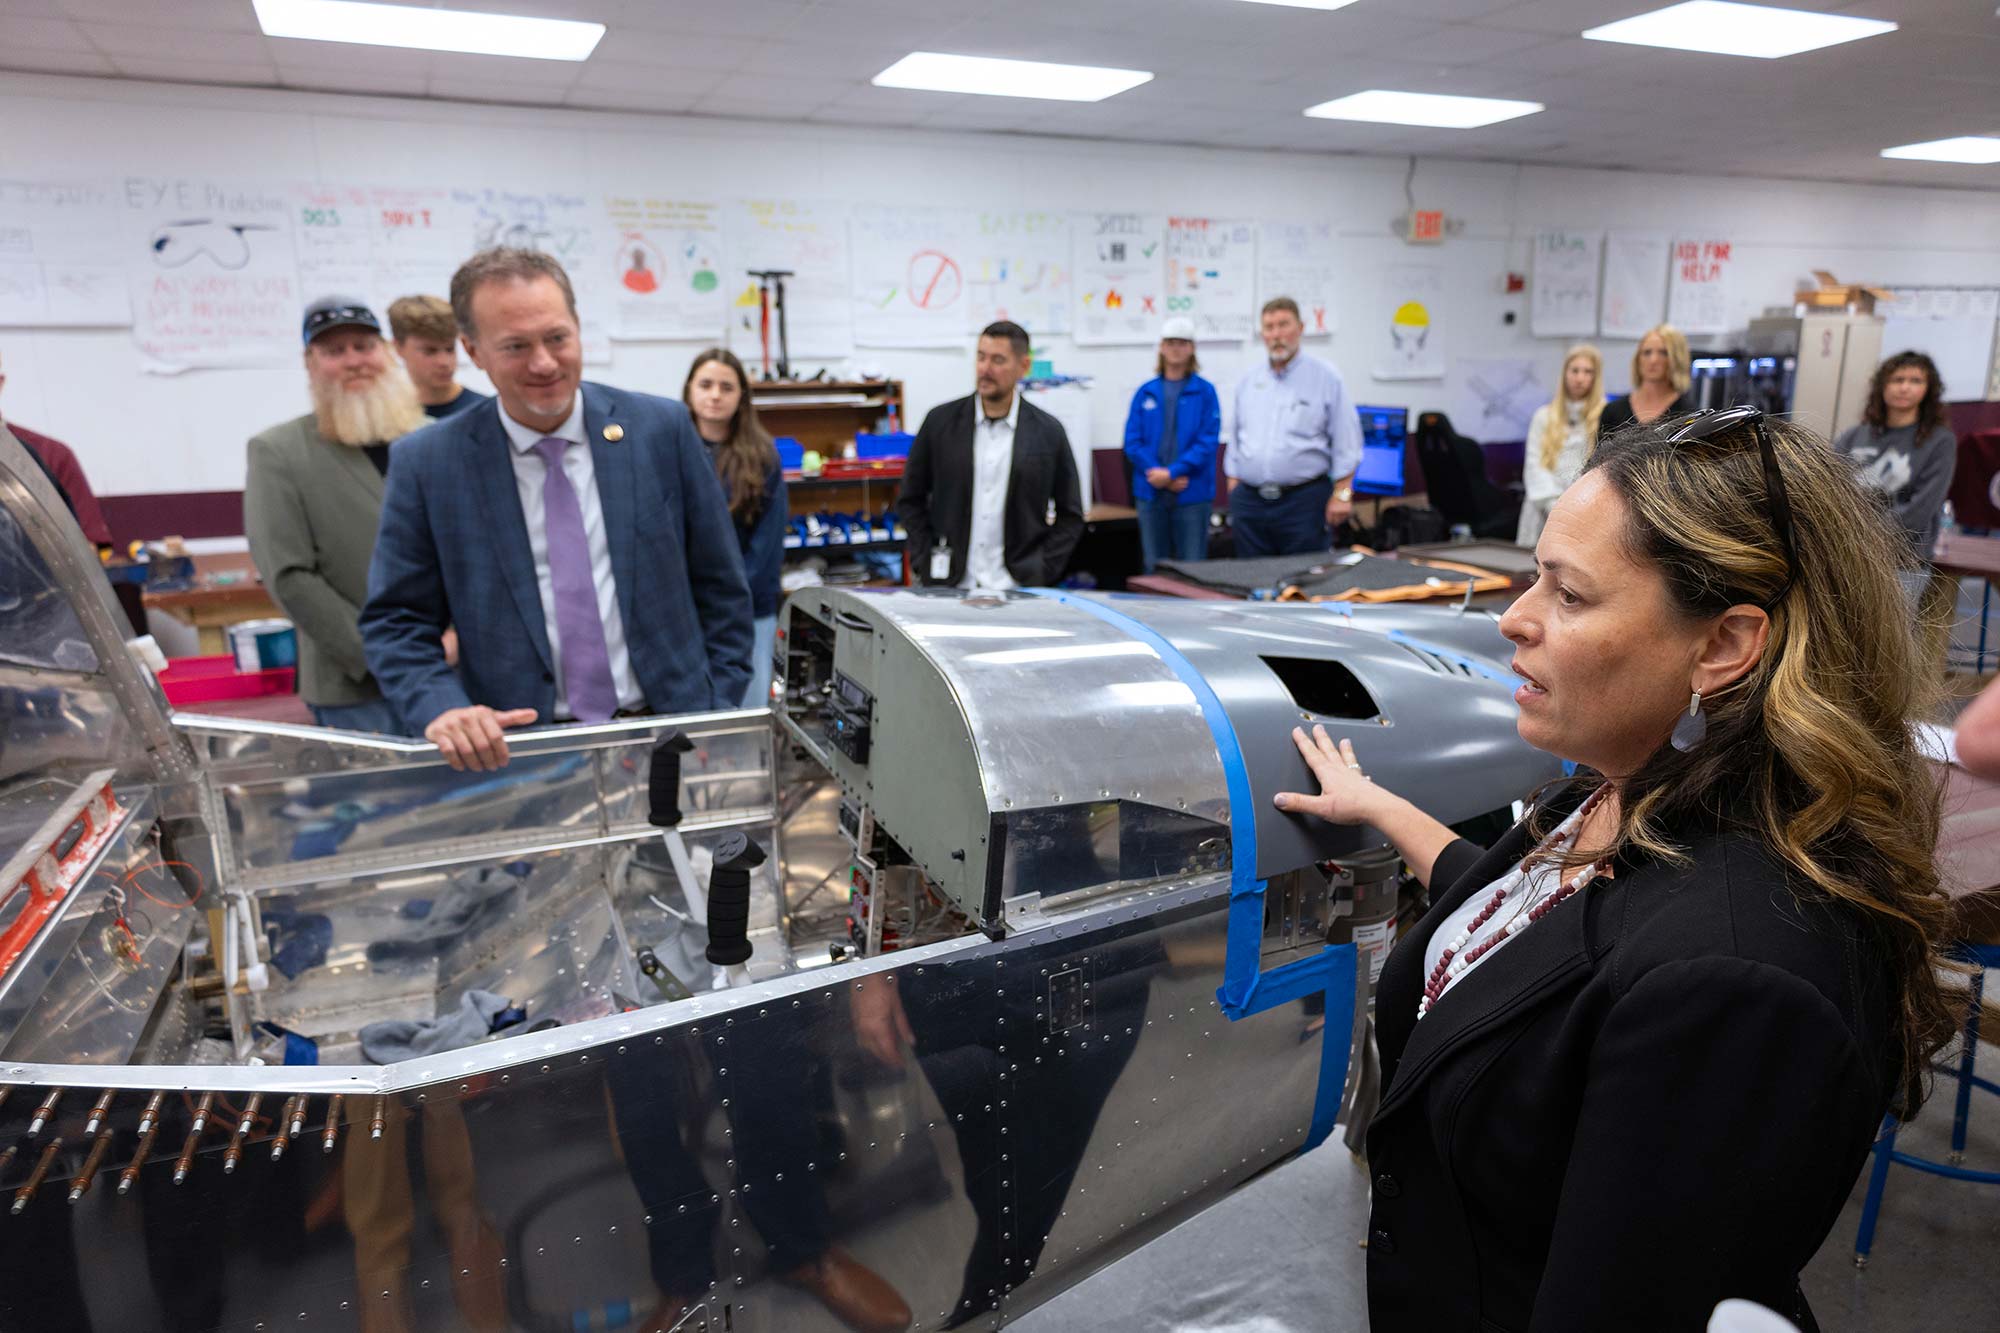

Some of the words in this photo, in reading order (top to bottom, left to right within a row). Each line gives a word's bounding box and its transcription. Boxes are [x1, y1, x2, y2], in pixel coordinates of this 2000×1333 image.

[124, 177, 193, 210] EYE
[1415, 211, 1443, 238] EXIT
[1675, 241, 1699, 261] ASK
[1704, 241, 1731, 261] FOR
[1681, 263, 1721, 282] HELP
